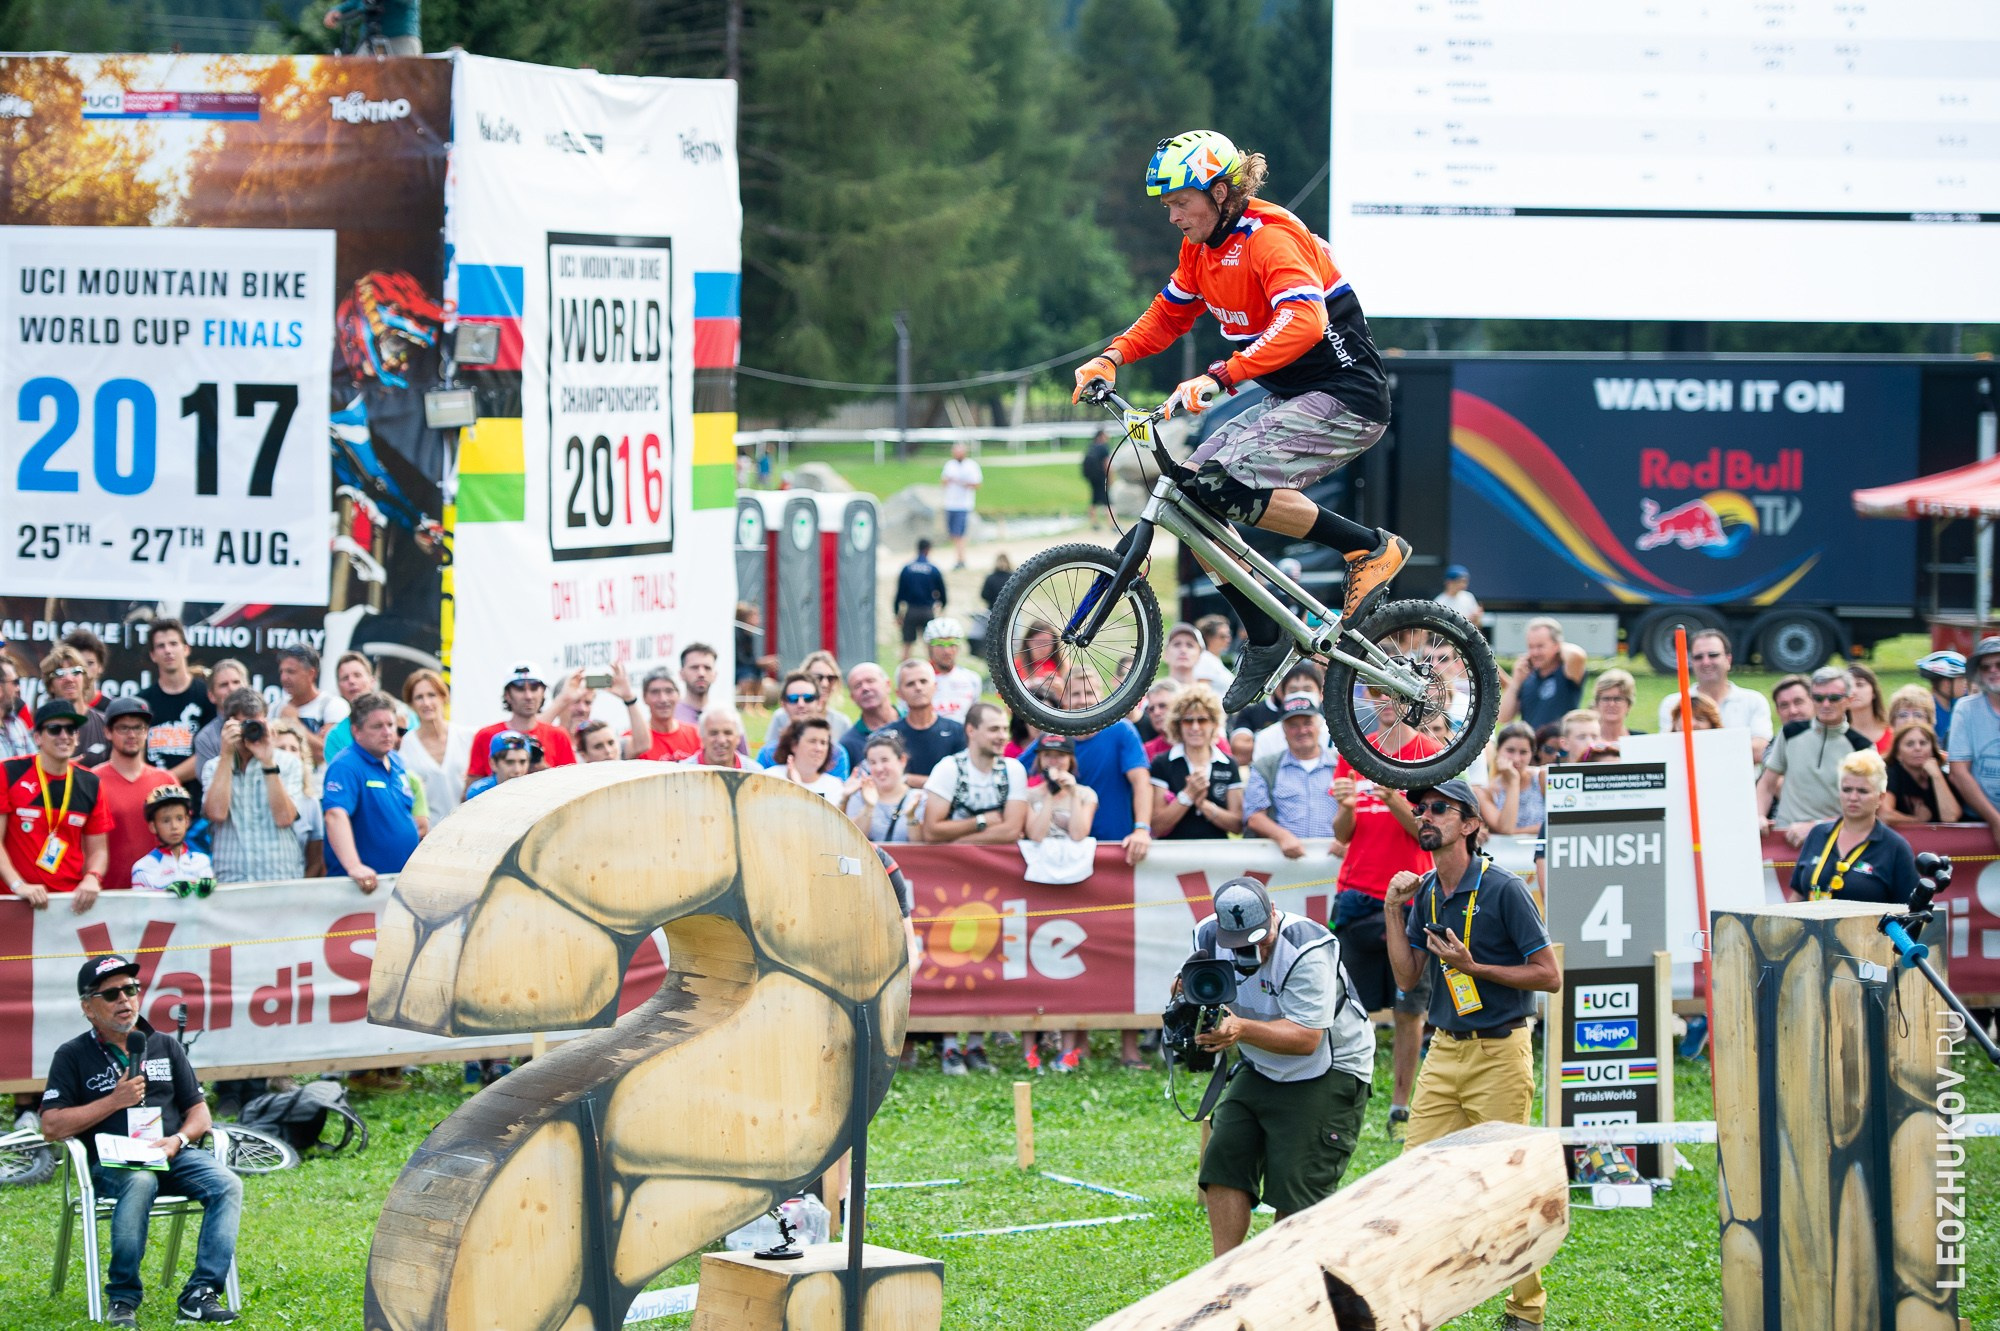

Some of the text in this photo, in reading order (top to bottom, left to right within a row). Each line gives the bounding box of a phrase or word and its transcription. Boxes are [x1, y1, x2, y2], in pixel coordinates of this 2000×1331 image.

[89, 94, 120, 109] UCI
[19, 268, 307, 299] UCI MOUNTAIN BIKE
[19, 316, 303, 349] WORLD CUP FINALS
[560, 297, 663, 364] WORLD
[560, 383, 660, 413] CHAMPIONSHIPS
[1594, 377, 1845, 414] WATCH IT ON
[17, 376, 299, 498] 2017
[564, 433, 664, 528] 2016
[1641, 447, 1804, 492] Red Bull
[1752, 494, 1803, 536] TV
[213, 530, 301, 566] AUG.
[31, 620, 58, 642] DI
[134, 623, 252, 649] TNTINO
[266, 627, 327, 650] ITALY
[1553, 777, 1579, 790] UCI
[1584, 780, 1652, 790] WORLD CHAMPIONSHIPS
[1551, 833, 1661, 869] FINISH
[1580, 884, 1632, 958] 4
[77, 919, 233, 1035] Val
[248, 962, 314, 1028] di
[1592, 992, 1630, 1009] UCI
[1583, 1024, 1630, 1042] TRENTINO
[1586, 1065, 1623, 1081] UCI
[1574, 1089, 1637, 1103] #TrialsWorlds
